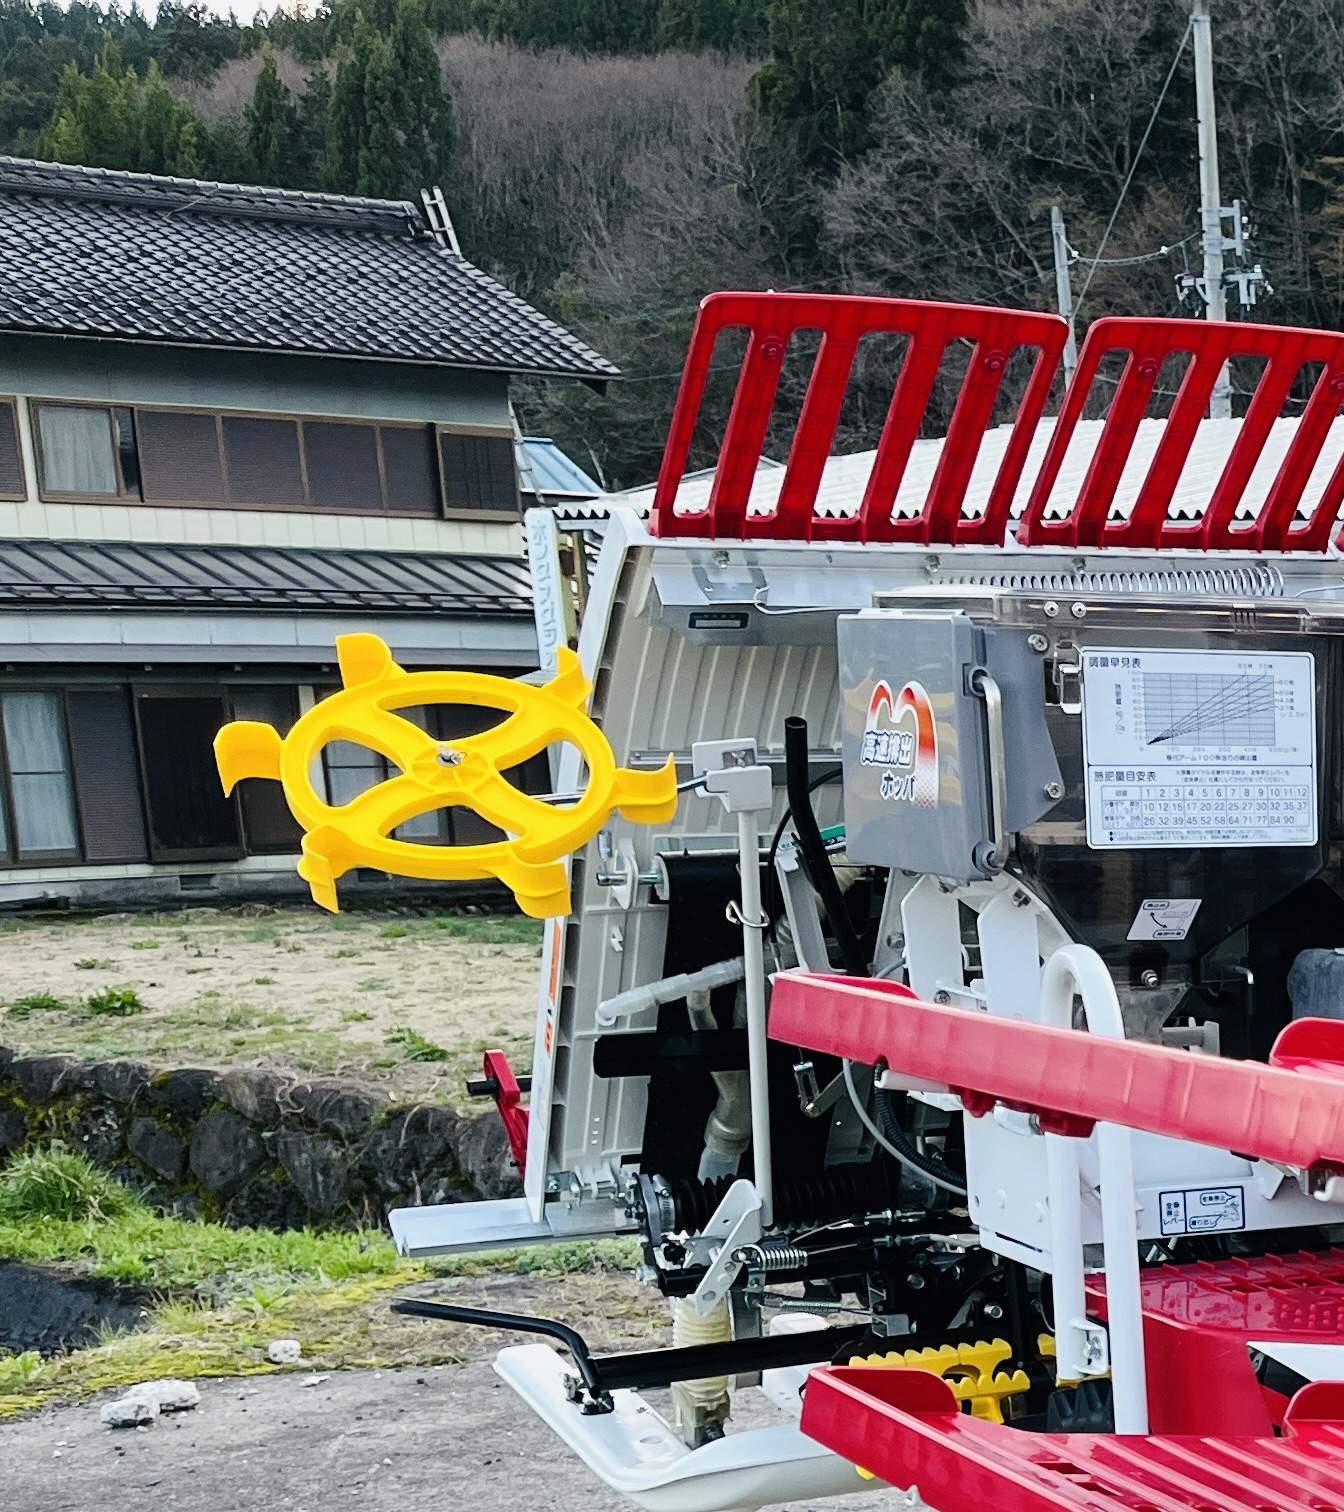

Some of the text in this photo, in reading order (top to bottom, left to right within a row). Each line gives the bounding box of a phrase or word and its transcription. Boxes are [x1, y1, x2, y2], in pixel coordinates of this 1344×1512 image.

[862, 730, 913, 766] 高速排出
[882, 772, 915, 799] ホッパ
[1146, 788, 1151, 797] 1
[1160, 788, 1166, 797] 2
[1174, 788, 1180, 797] 3
[1188, 788, 1194, 797] 4
[1202, 788, 1208, 797] 5
[1216, 788, 1222, 797] 6
[1230, 788, 1236, 797] 7
[1244, 788, 1250, 797] 8
[1258, 788, 1264, 797] 9
[1271, 788, 1281, 797] 10
[1284, 788, 1293, 797] 11
[1297, 788, 1306, 797] 12
[1144, 803, 1154, 811] 10
[1158, 803, 1169, 811] 12
[1187, 803, 1197, 811] 17
[1200, 803, 1211, 811] 20
[1214, 803, 1225, 811] 22
[1228, 802, 1239, 810] 25
[1242, 802, 1253, 810] 27
[1256, 802, 1267, 810] 30
[1270, 802, 1280, 810] 32
[1283, 802, 1294, 810] 35
[1297, 802, 1307, 810] 37
[1158, 816, 1169, 825] 32
[1172, 816, 1183, 825] 39
[1187, 816, 1198, 825] 45
[1200, 816, 1211, 825] 52
[1228, 816, 1239, 825] 64
[1243, 816, 1252, 825] 71
[1256, 816, 1267, 825] 77
[1270, 816, 1280, 825] 84
[1284, 816, 1294, 825] 90
